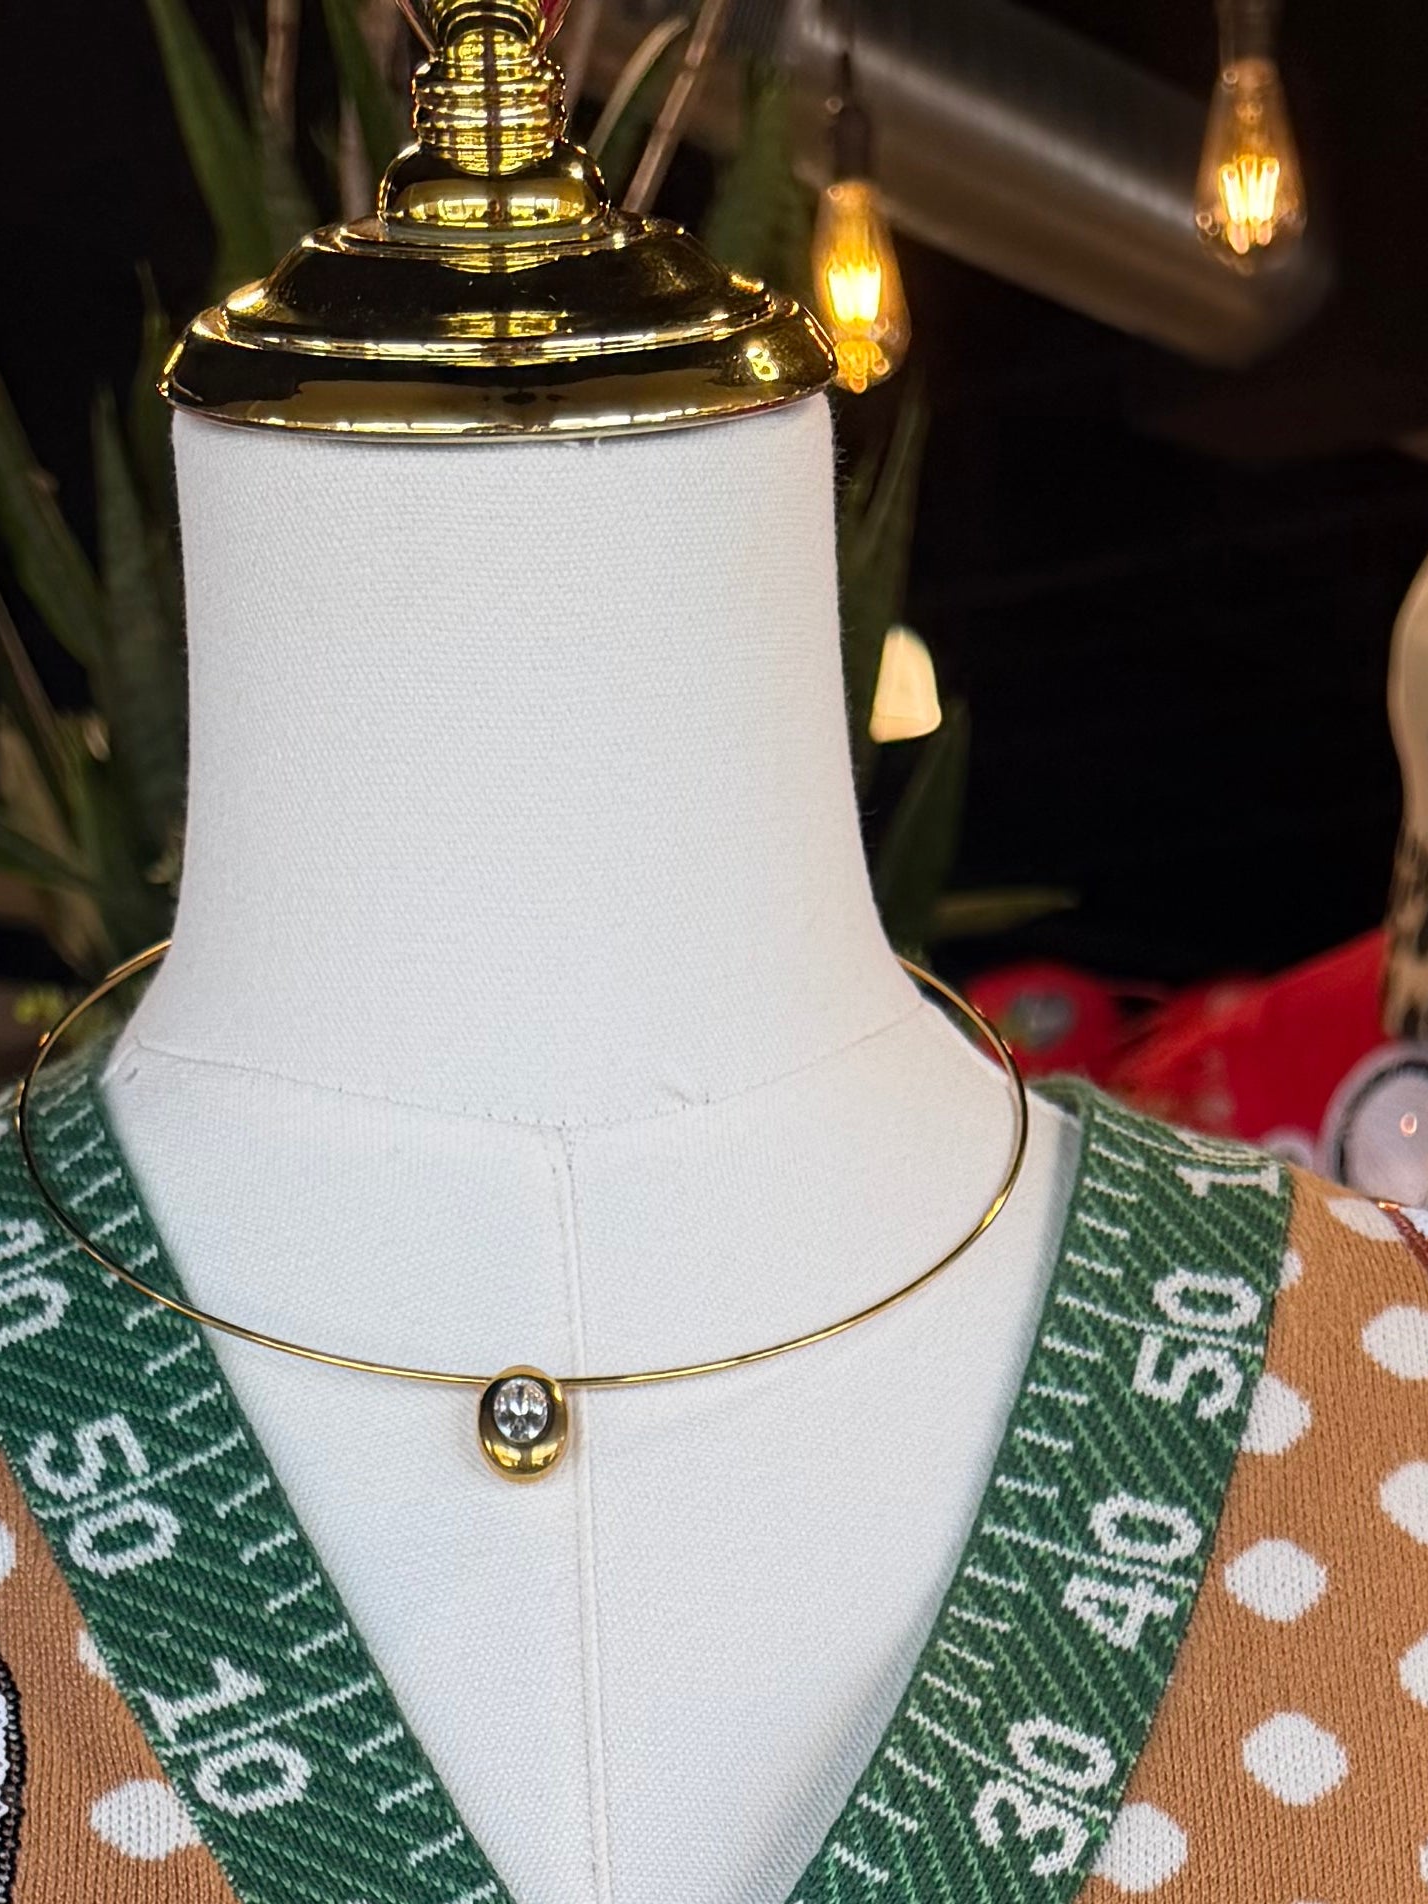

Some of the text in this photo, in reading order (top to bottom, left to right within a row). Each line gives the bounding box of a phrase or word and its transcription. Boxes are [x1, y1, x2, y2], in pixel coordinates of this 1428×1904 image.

[1131, 1268, 1262, 1422] 50
[27, 1415, 181, 1579] 50
[1061, 1490, 1203, 1650] 40
[146, 1656, 313, 1816] 10
[972, 1711, 1117, 1877] 30
